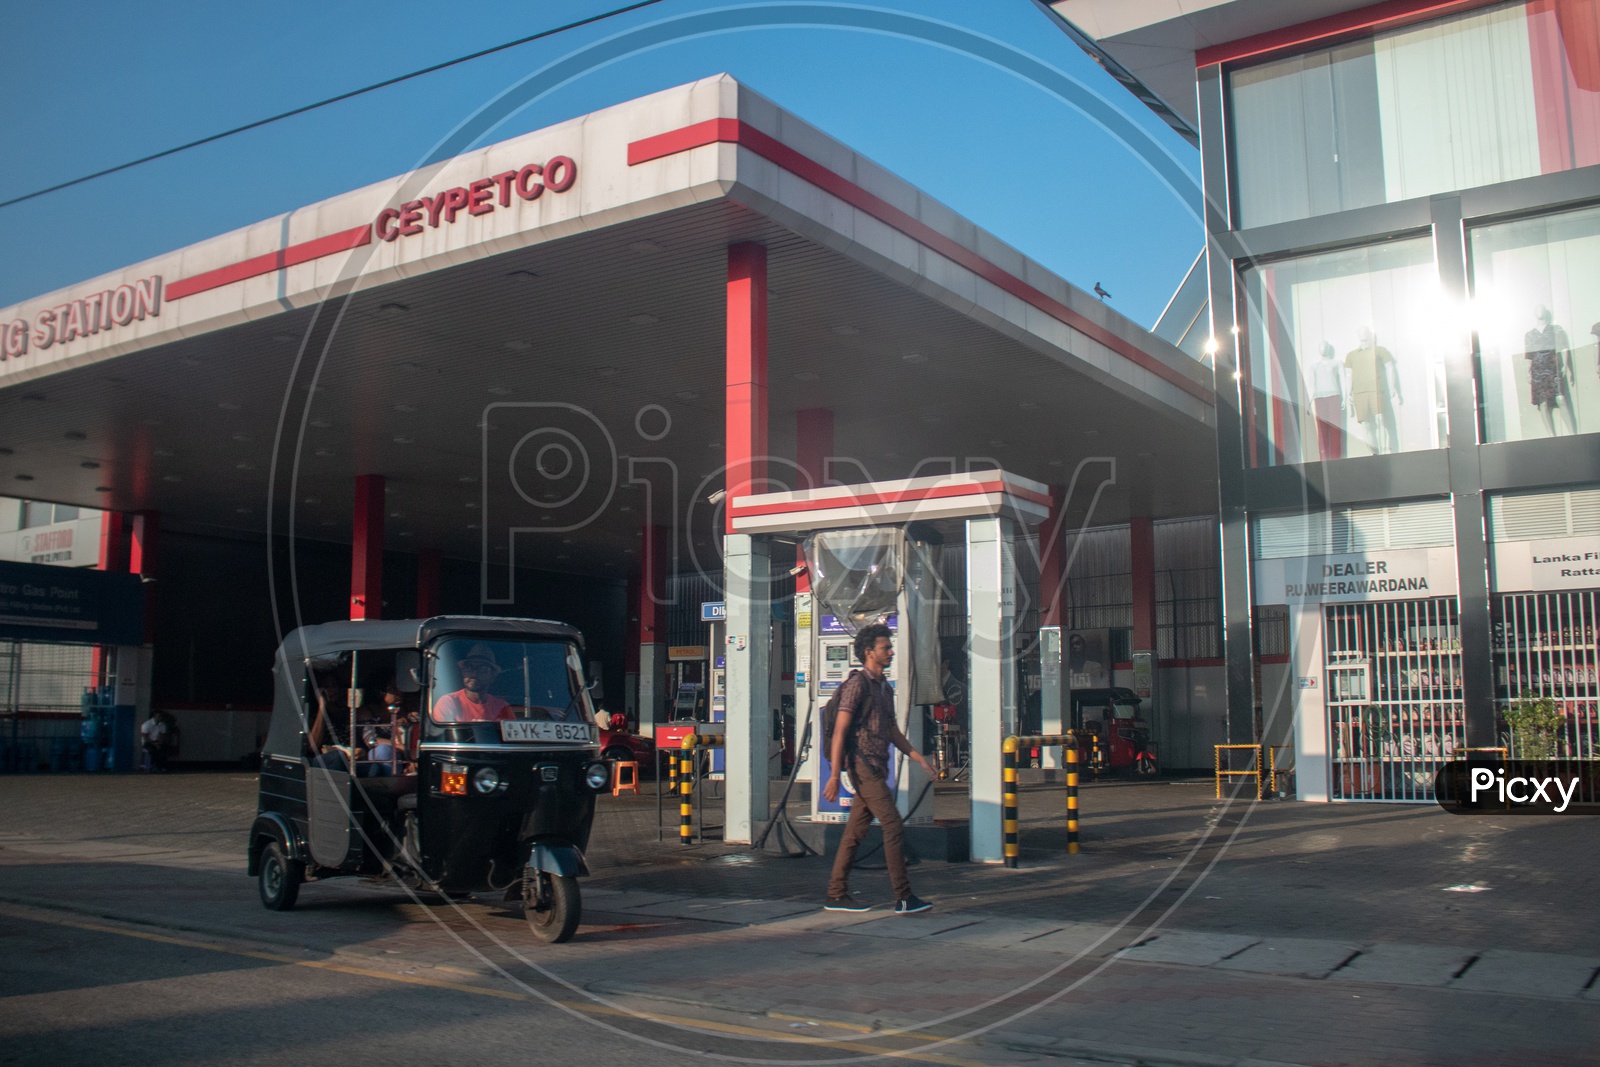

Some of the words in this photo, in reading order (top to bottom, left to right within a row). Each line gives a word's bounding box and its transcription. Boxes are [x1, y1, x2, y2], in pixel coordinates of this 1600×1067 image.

[375, 154, 578, 243] CEYPETCO
[32, 273, 162, 350] STATION
[1533, 554, 1581, 564] Lanka
[1321, 560, 1387, 578] DEALER
[22, 584, 46, 597] Gas
[50, 586, 79, 599] Point
[1285, 577, 1429, 597] P.U.WEERAWARDANA
